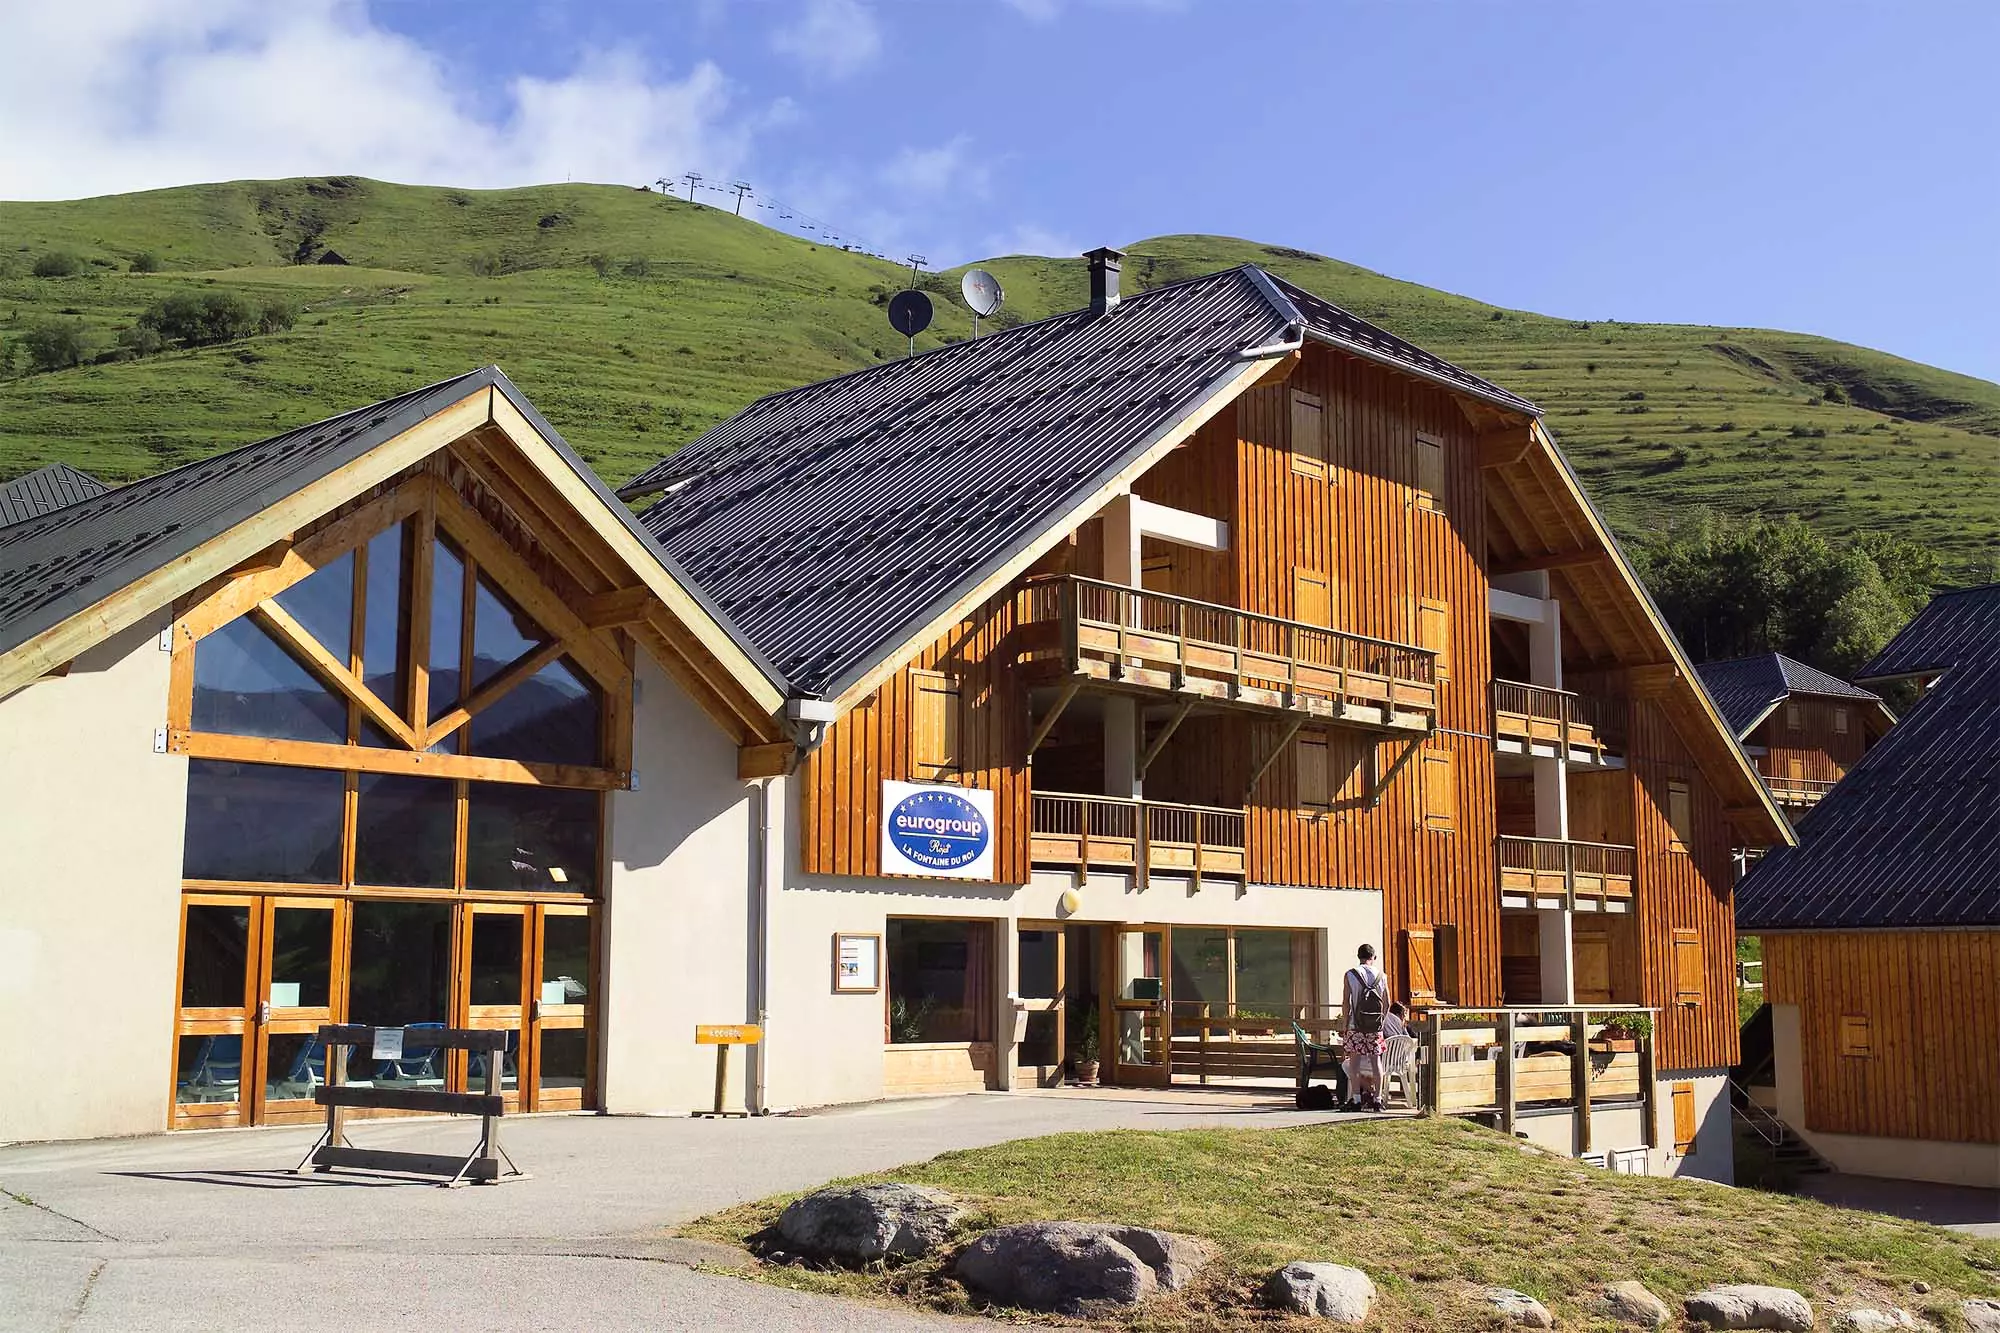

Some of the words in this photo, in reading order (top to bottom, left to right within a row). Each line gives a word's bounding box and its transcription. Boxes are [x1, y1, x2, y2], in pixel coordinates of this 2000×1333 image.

[896, 815, 982, 836] eurogroup
[902, 843, 912, 856] LA
[913, 850, 950, 866] FONTAINE
[950, 856, 962, 866] DU
[962, 850, 975, 862] ROI
